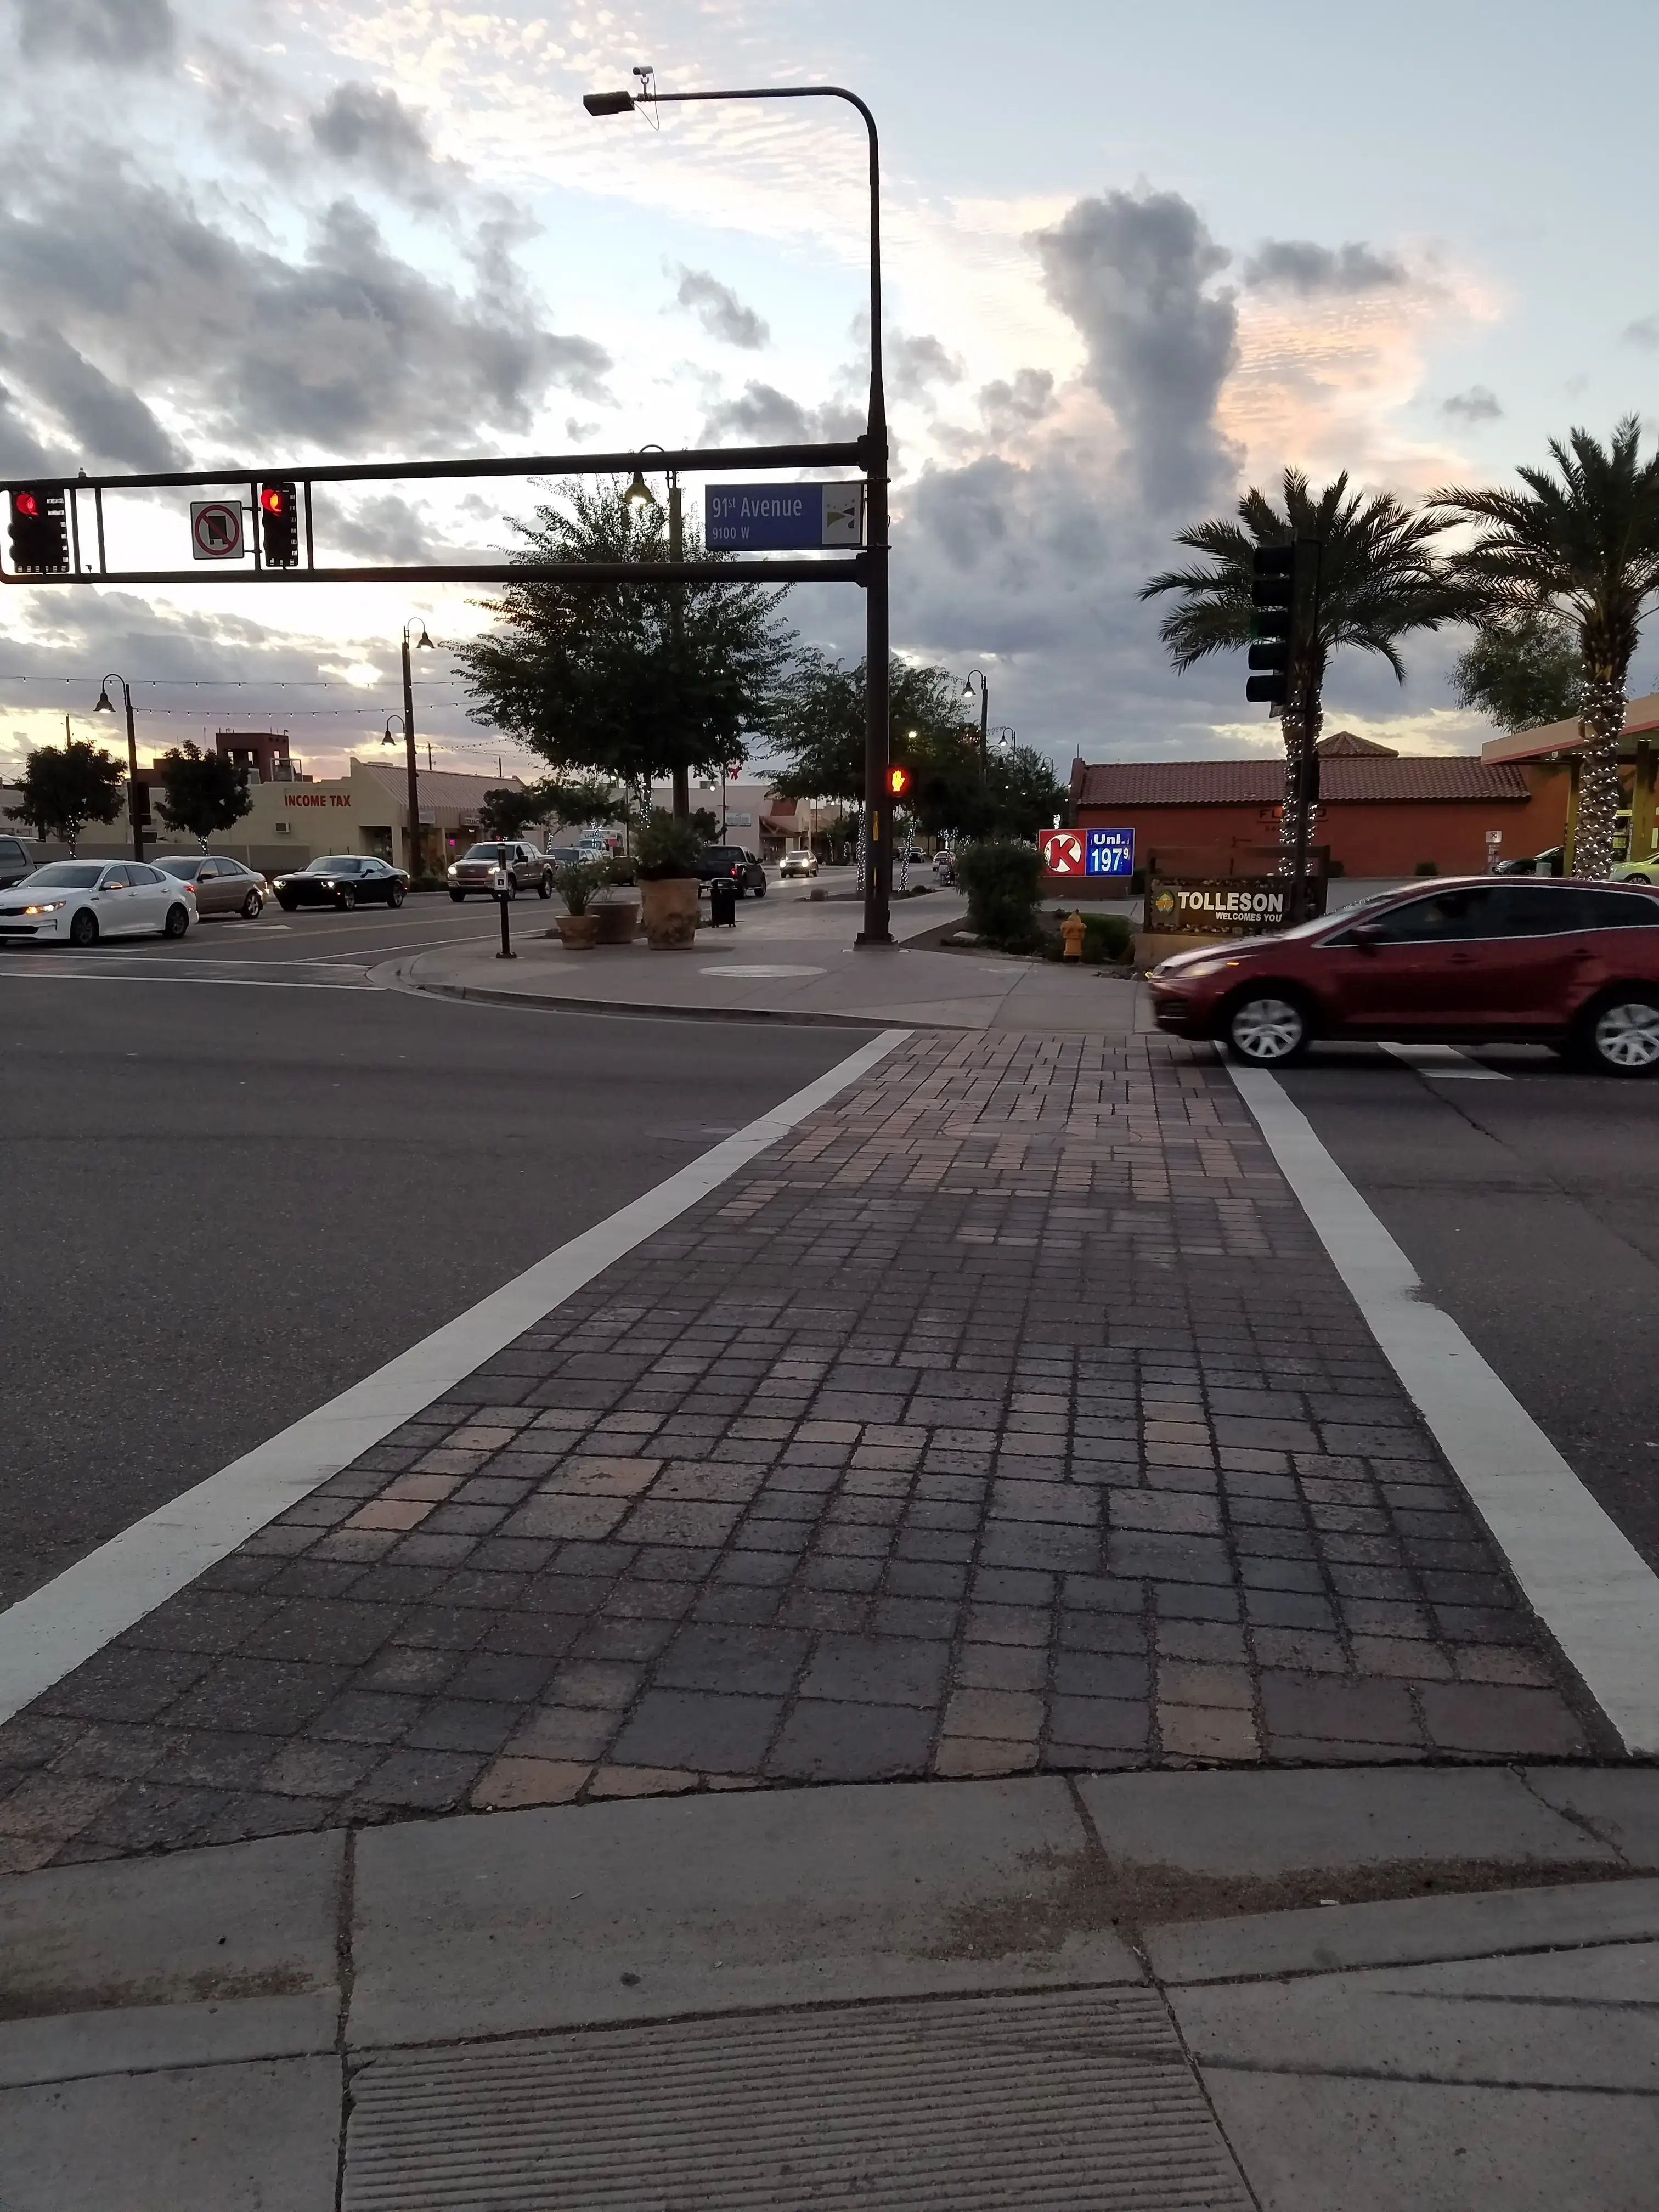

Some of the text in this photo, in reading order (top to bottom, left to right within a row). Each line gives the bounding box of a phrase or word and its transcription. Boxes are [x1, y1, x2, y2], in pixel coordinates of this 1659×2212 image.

[713, 497, 802, 517] 91st Avenue
[713, 527, 749, 539] 9100 W
[285, 795, 351, 806] INCOME TAX
[1094, 834, 1125, 844] Unl.
[1178, 891, 1283, 912] TOLLESON
[1216, 912, 1261, 921] WELCOMES
